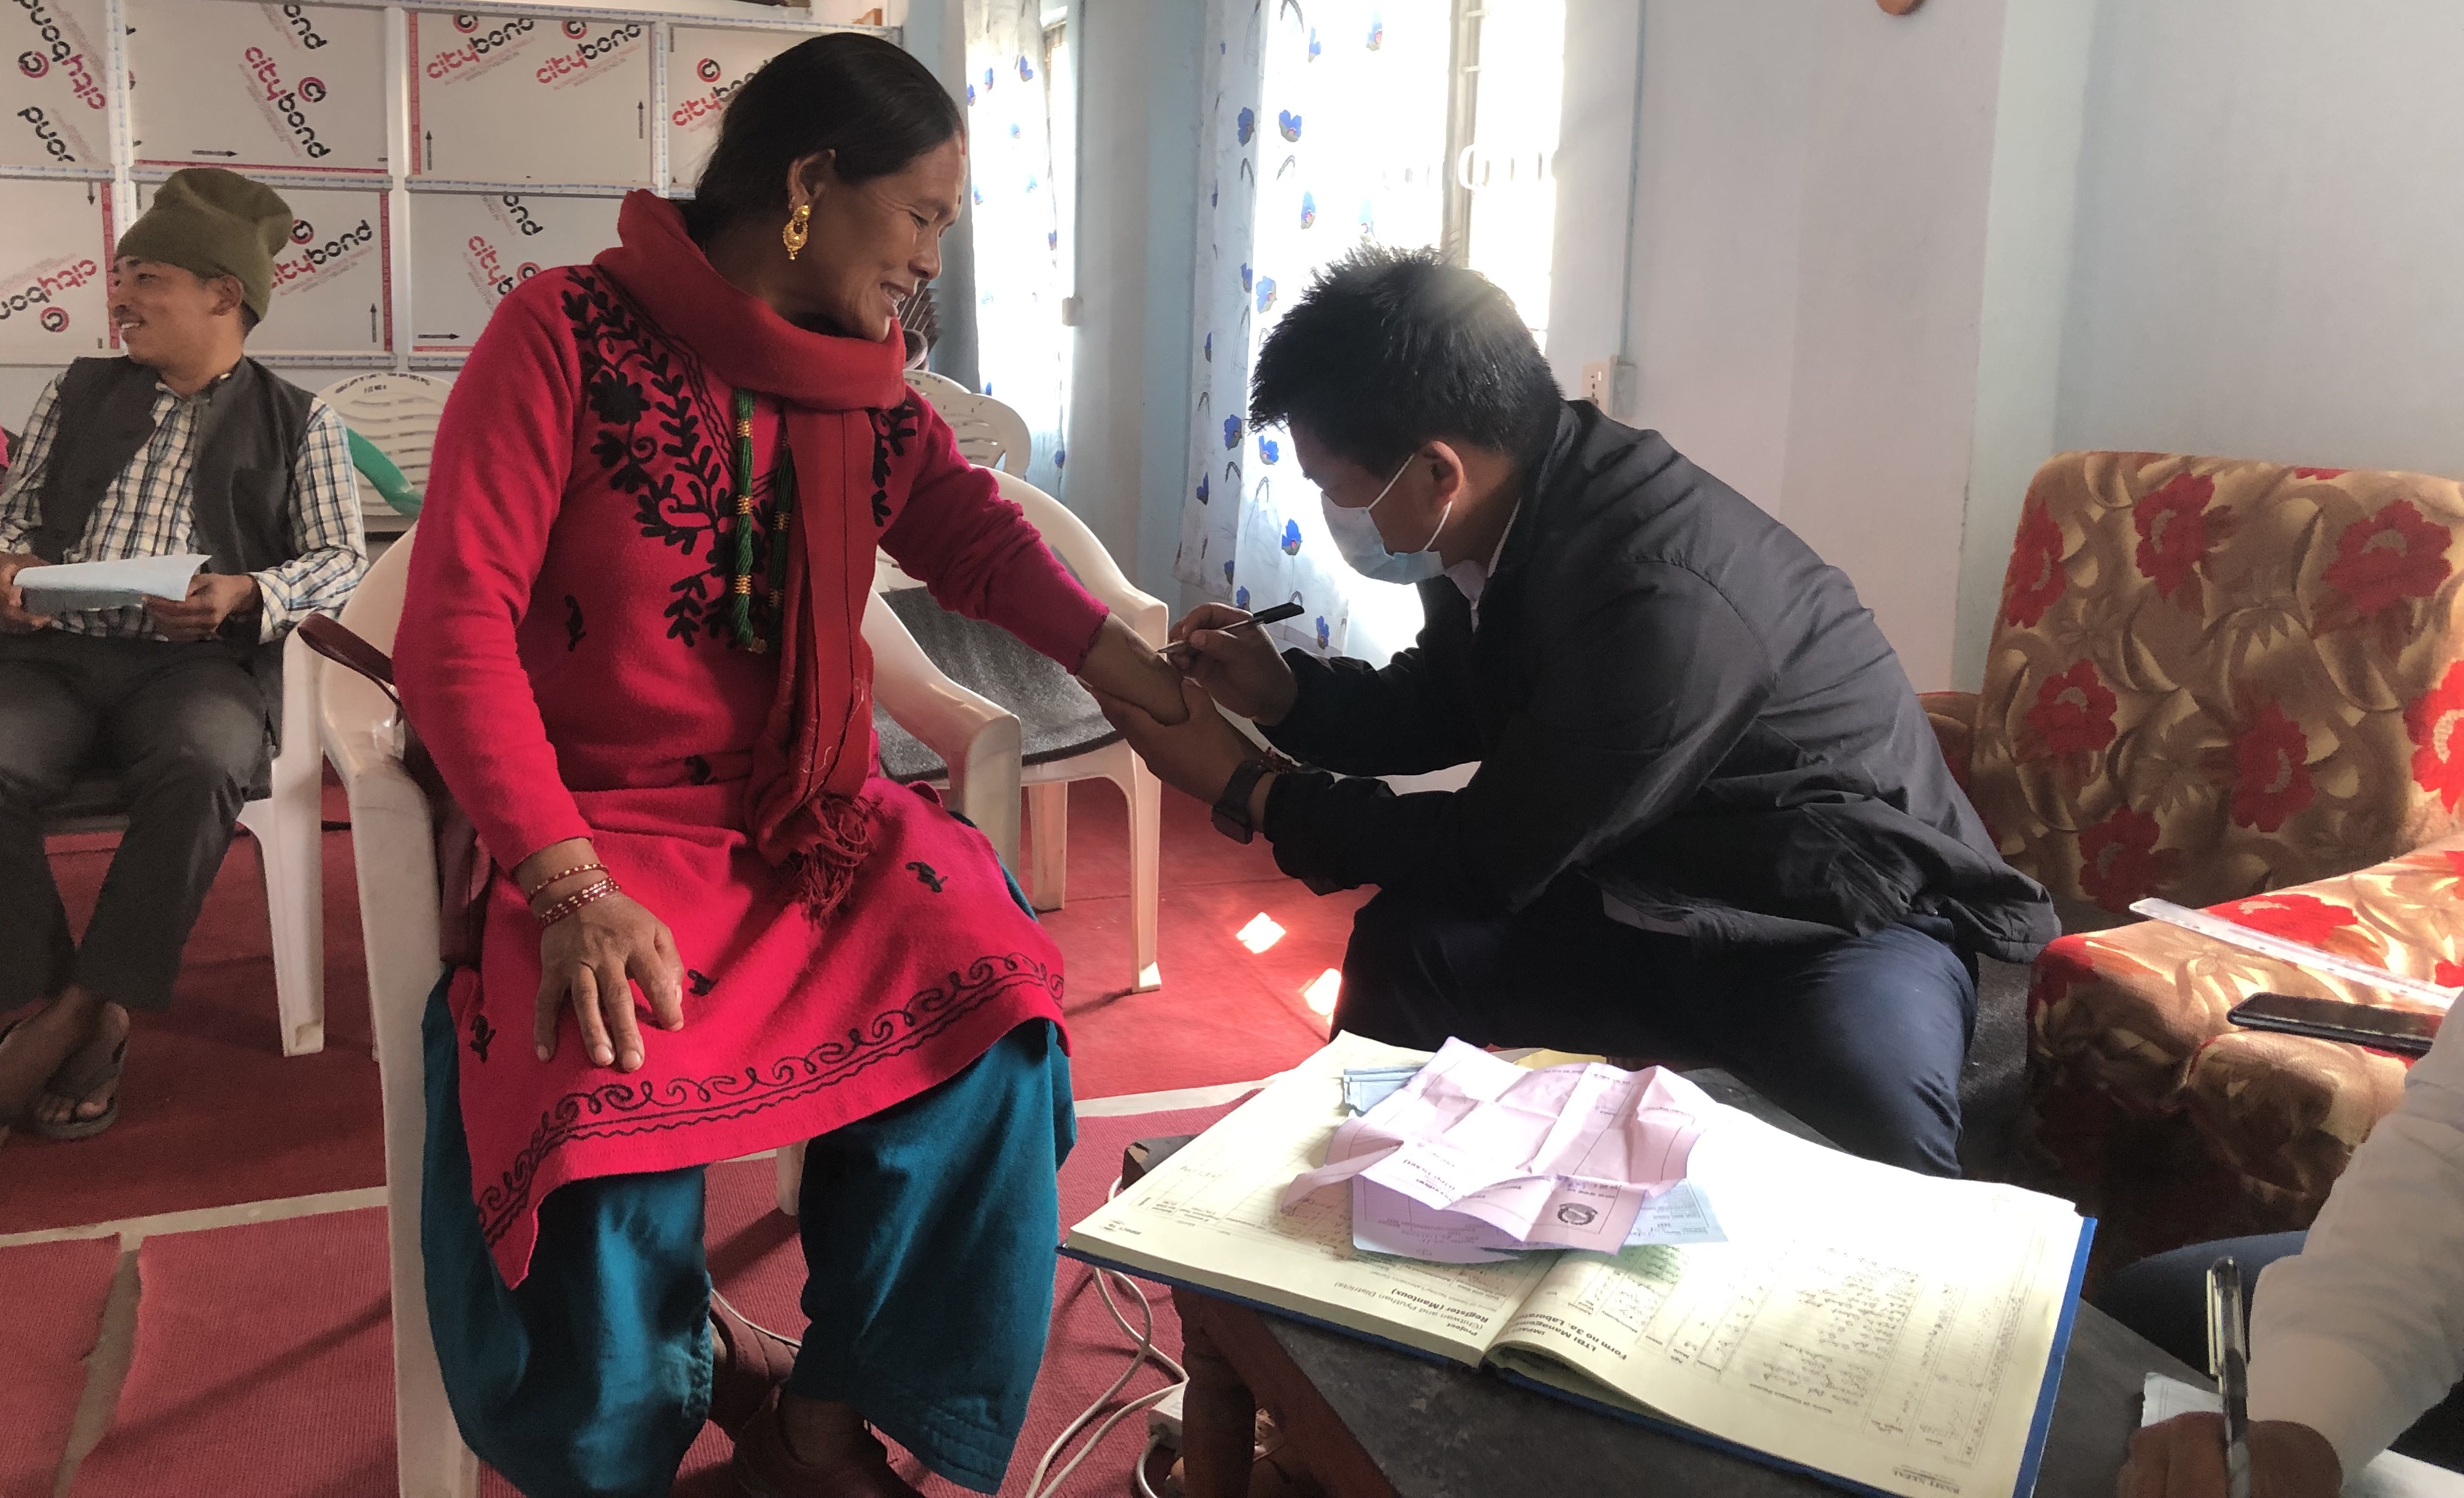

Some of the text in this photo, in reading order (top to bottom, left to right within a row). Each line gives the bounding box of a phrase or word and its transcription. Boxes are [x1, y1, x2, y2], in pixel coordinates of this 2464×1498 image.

[245, 47, 331, 158] citybond
[272, 219, 372, 289] itybond
[1334, 1282, 1377, 1297] Districts)
[1378, 1294, 1417, 1311] Pyuthan
[1391, 1288, 1444, 1310] (Mantoux)
[1418, 1307, 1438, 1316] and
[1447, 1307, 1489, 1323] Register
[1441, 1313, 1483, 1330] (Chitwan
[1446, 1323, 1478, 1336] Project
[1574, 1337, 1596, 1351] LTBI
[1586, 1333, 1599, 1343] no
[1601, 1342, 1627, 1360] Form
